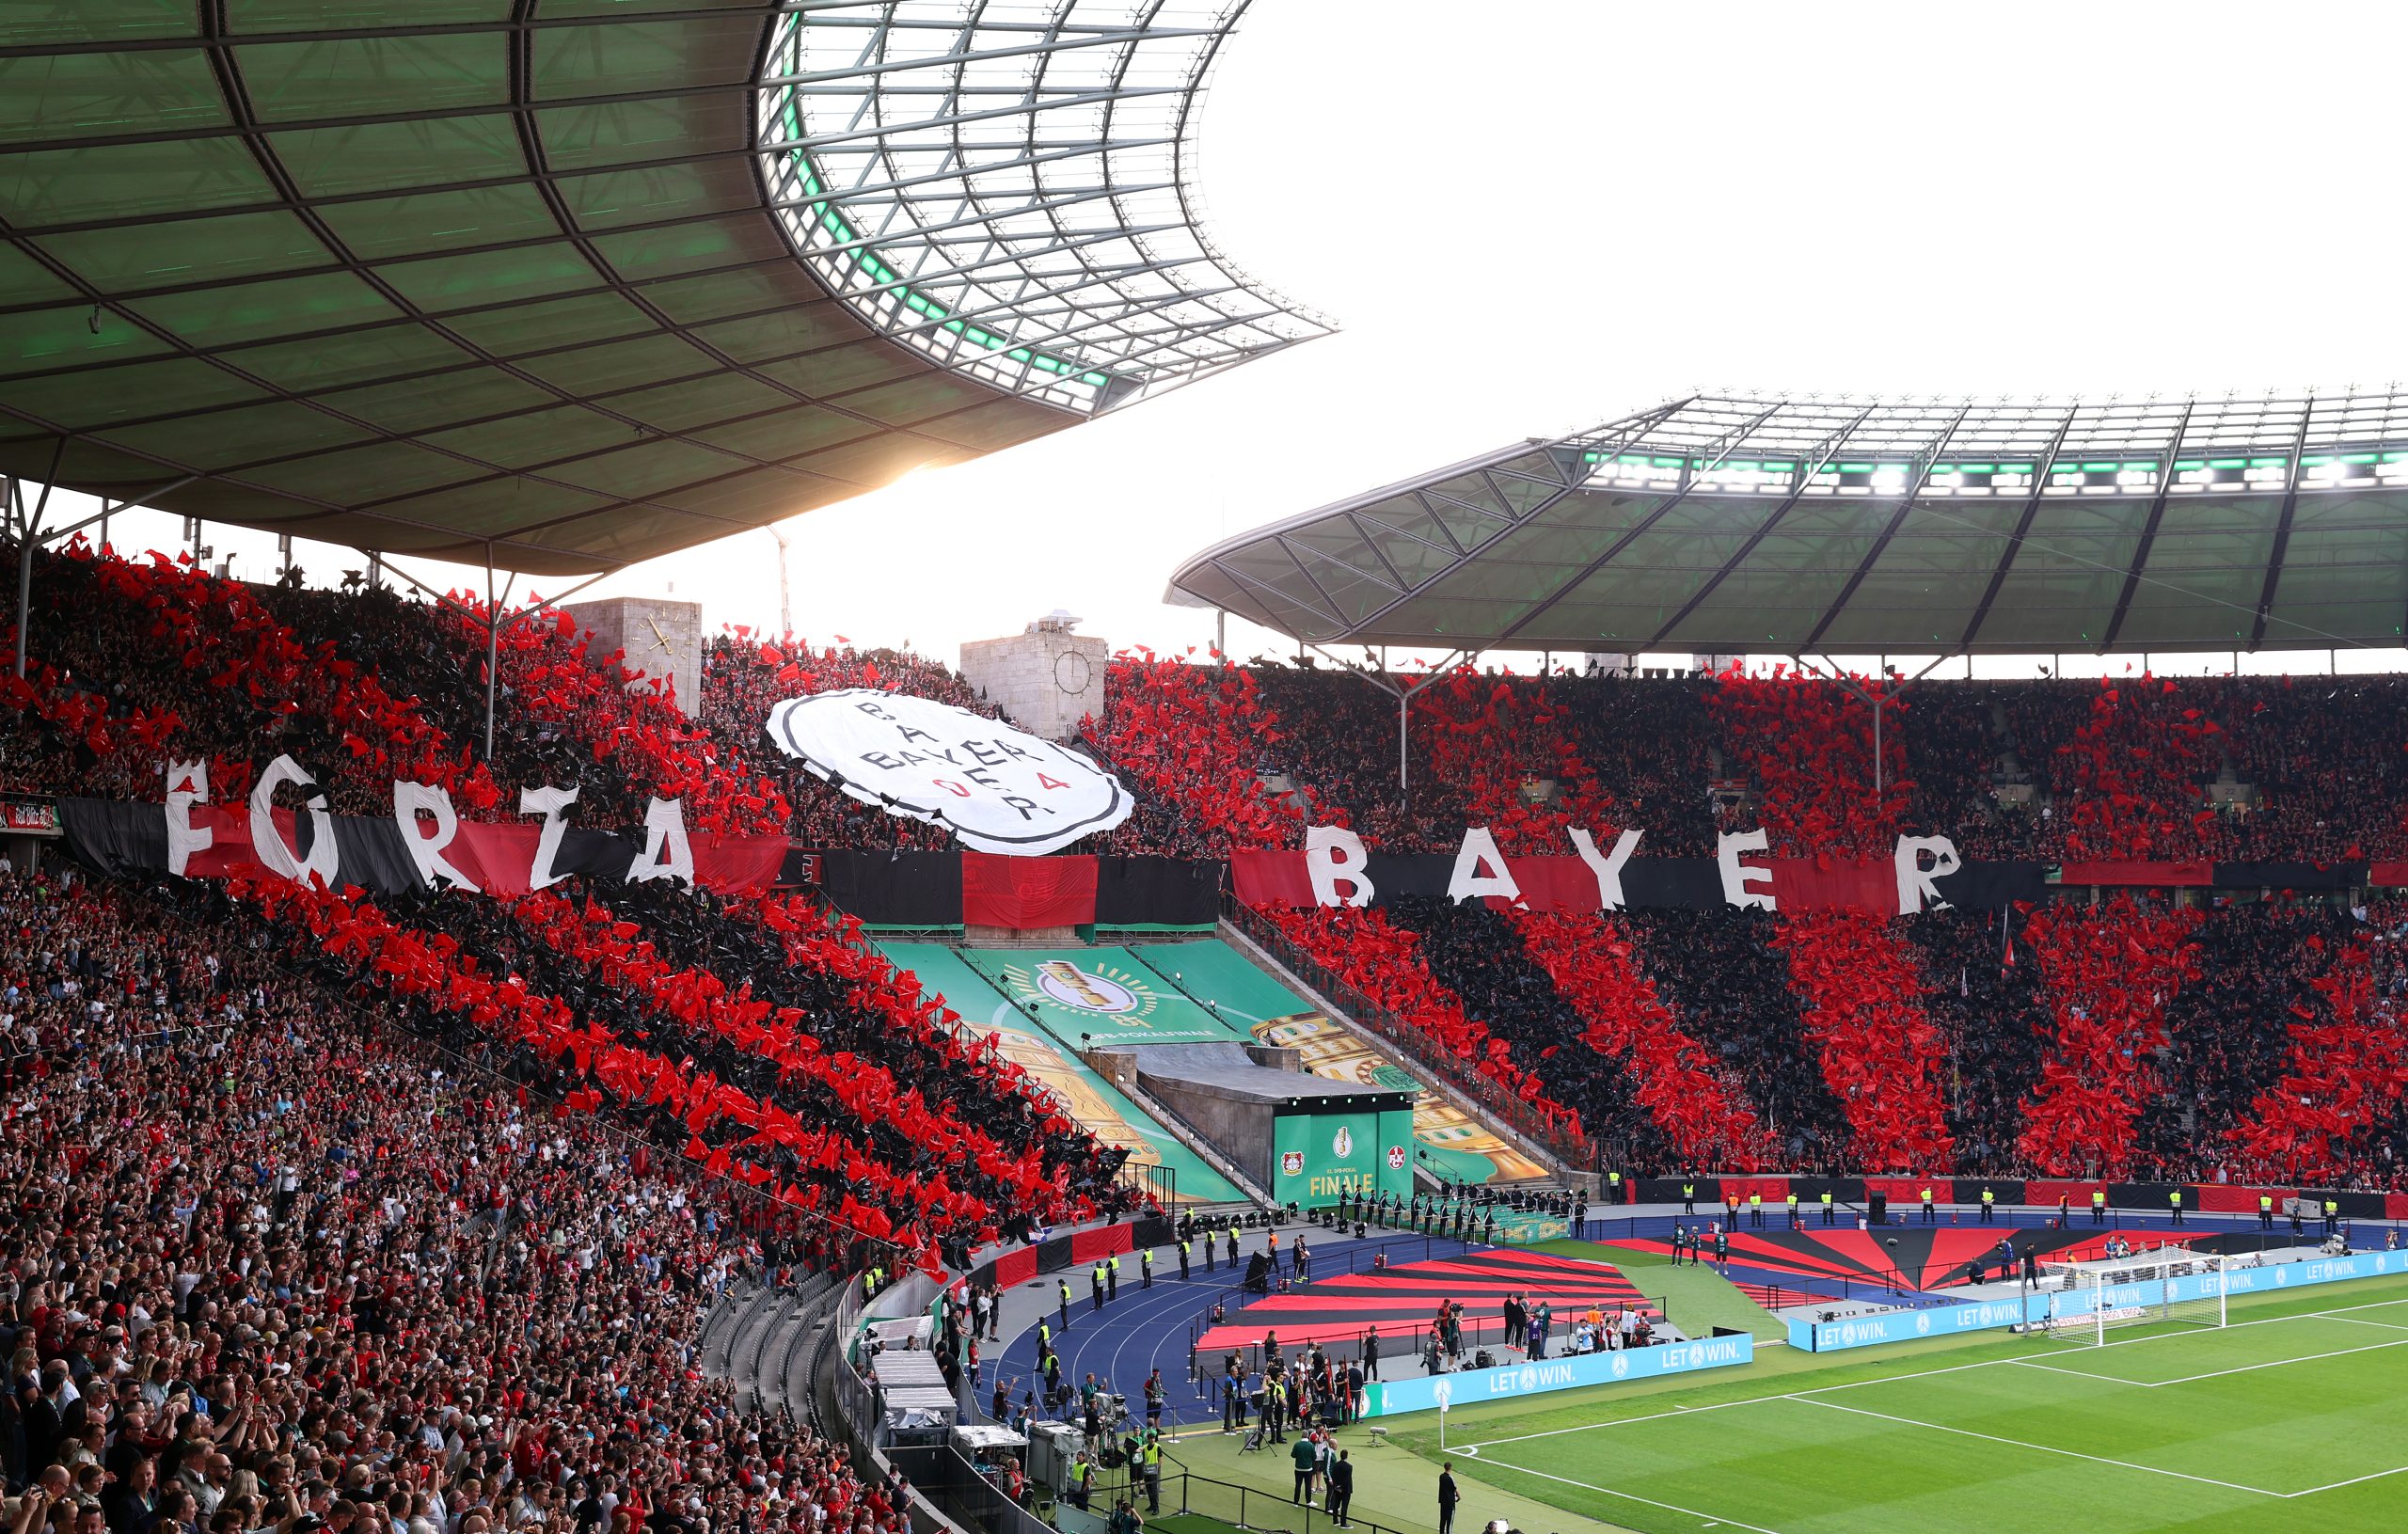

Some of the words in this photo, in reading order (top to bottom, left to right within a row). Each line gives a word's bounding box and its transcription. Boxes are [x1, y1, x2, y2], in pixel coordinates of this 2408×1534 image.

[166, 753, 696, 894] FORZA
[1305, 823, 1962, 915] BAYER
[1309, 1173, 1374, 1197] FINALE
[2306, 1264, 2323, 1280] LET
[2200, 1277, 2219, 1293] LET
[1957, 1308, 1978, 1326] LET
[1817, 1326, 1842, 1346] LET
[1662, 1348, 1688, 1368] LET
[1705, 1342, 1740, 1362] WIN.
[1490, 1371, 1518, 1393] LET
[1538, 1364, 1576, 1386] WIN.
